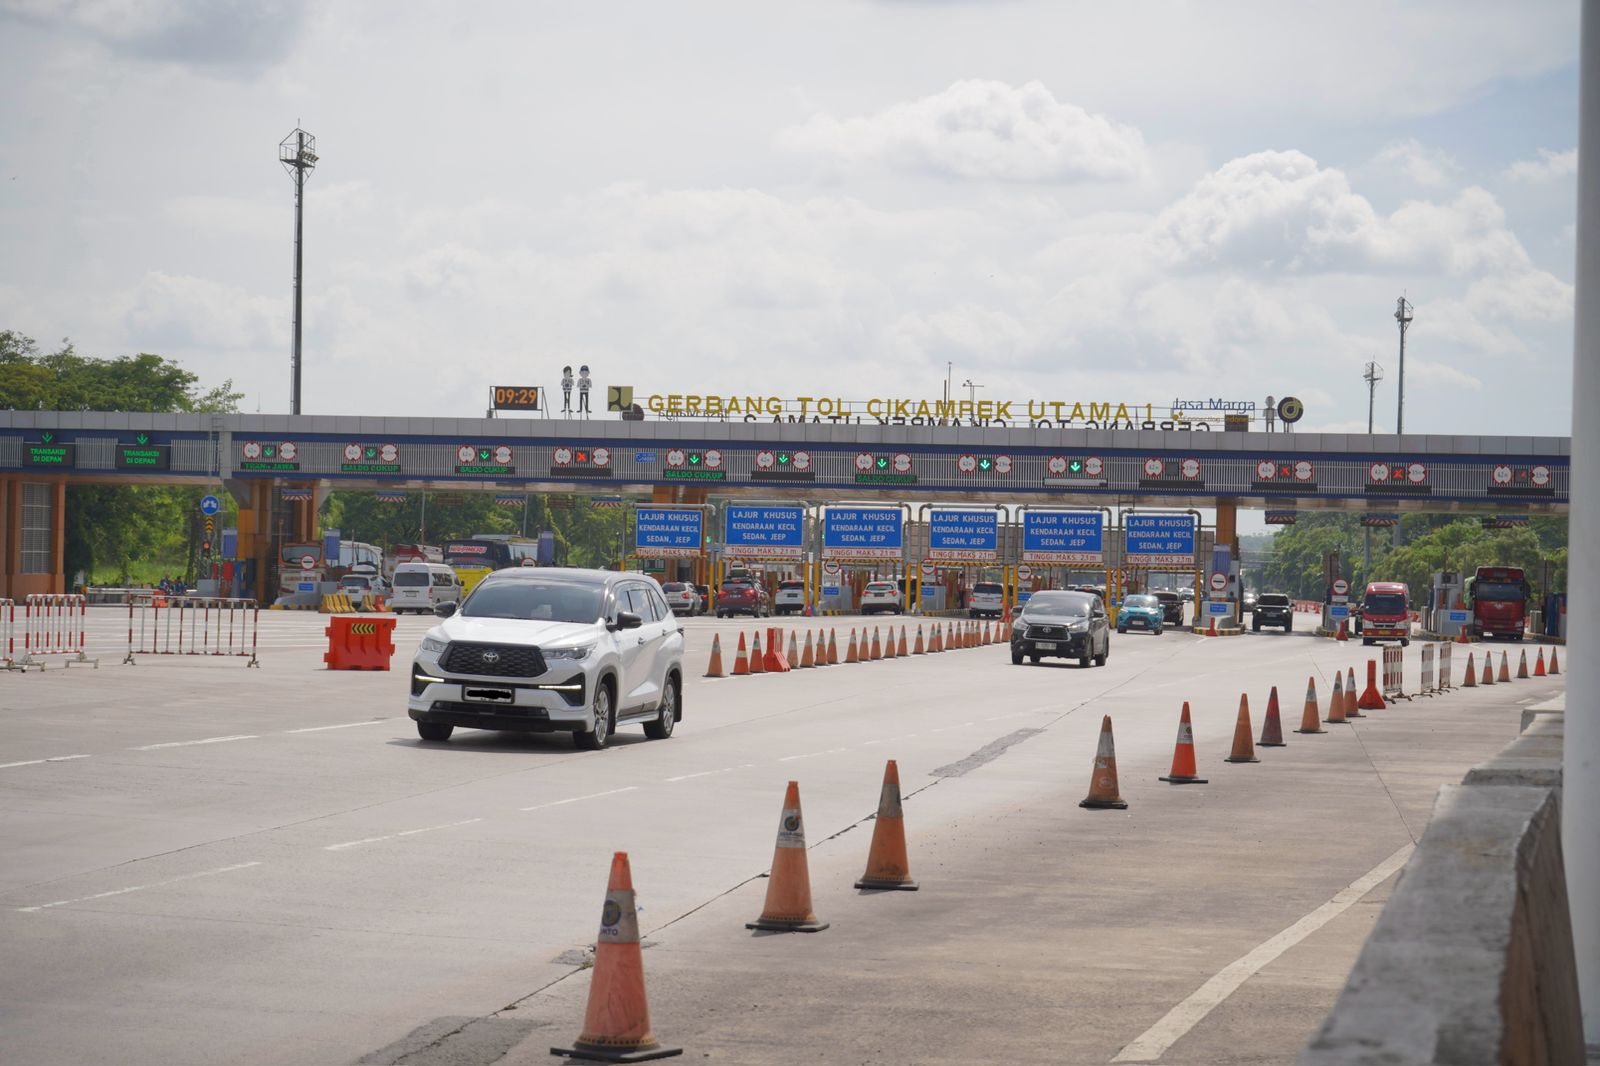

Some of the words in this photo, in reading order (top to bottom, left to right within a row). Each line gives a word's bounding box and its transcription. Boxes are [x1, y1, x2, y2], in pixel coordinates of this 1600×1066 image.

[496, 389, 537, 404] 09:29
[648, 394, 782, 414] GERBANG
[797, 396, 852, 417] TOL
[867, 398, 1013, 420] CIKAMPEK
[1028, 400, 1130, 421] UTAMA
[1146, 402, 1152, 421] 1
[1175, 398, 1204, 411] Jasa
[1209, 398, 1256, 414] Marga
[30, 448, 66, 456] TRANSAKSI
[123, 450, 160, 458] TRANSAKSI
[694, 471, 723, 479] CUKUP
